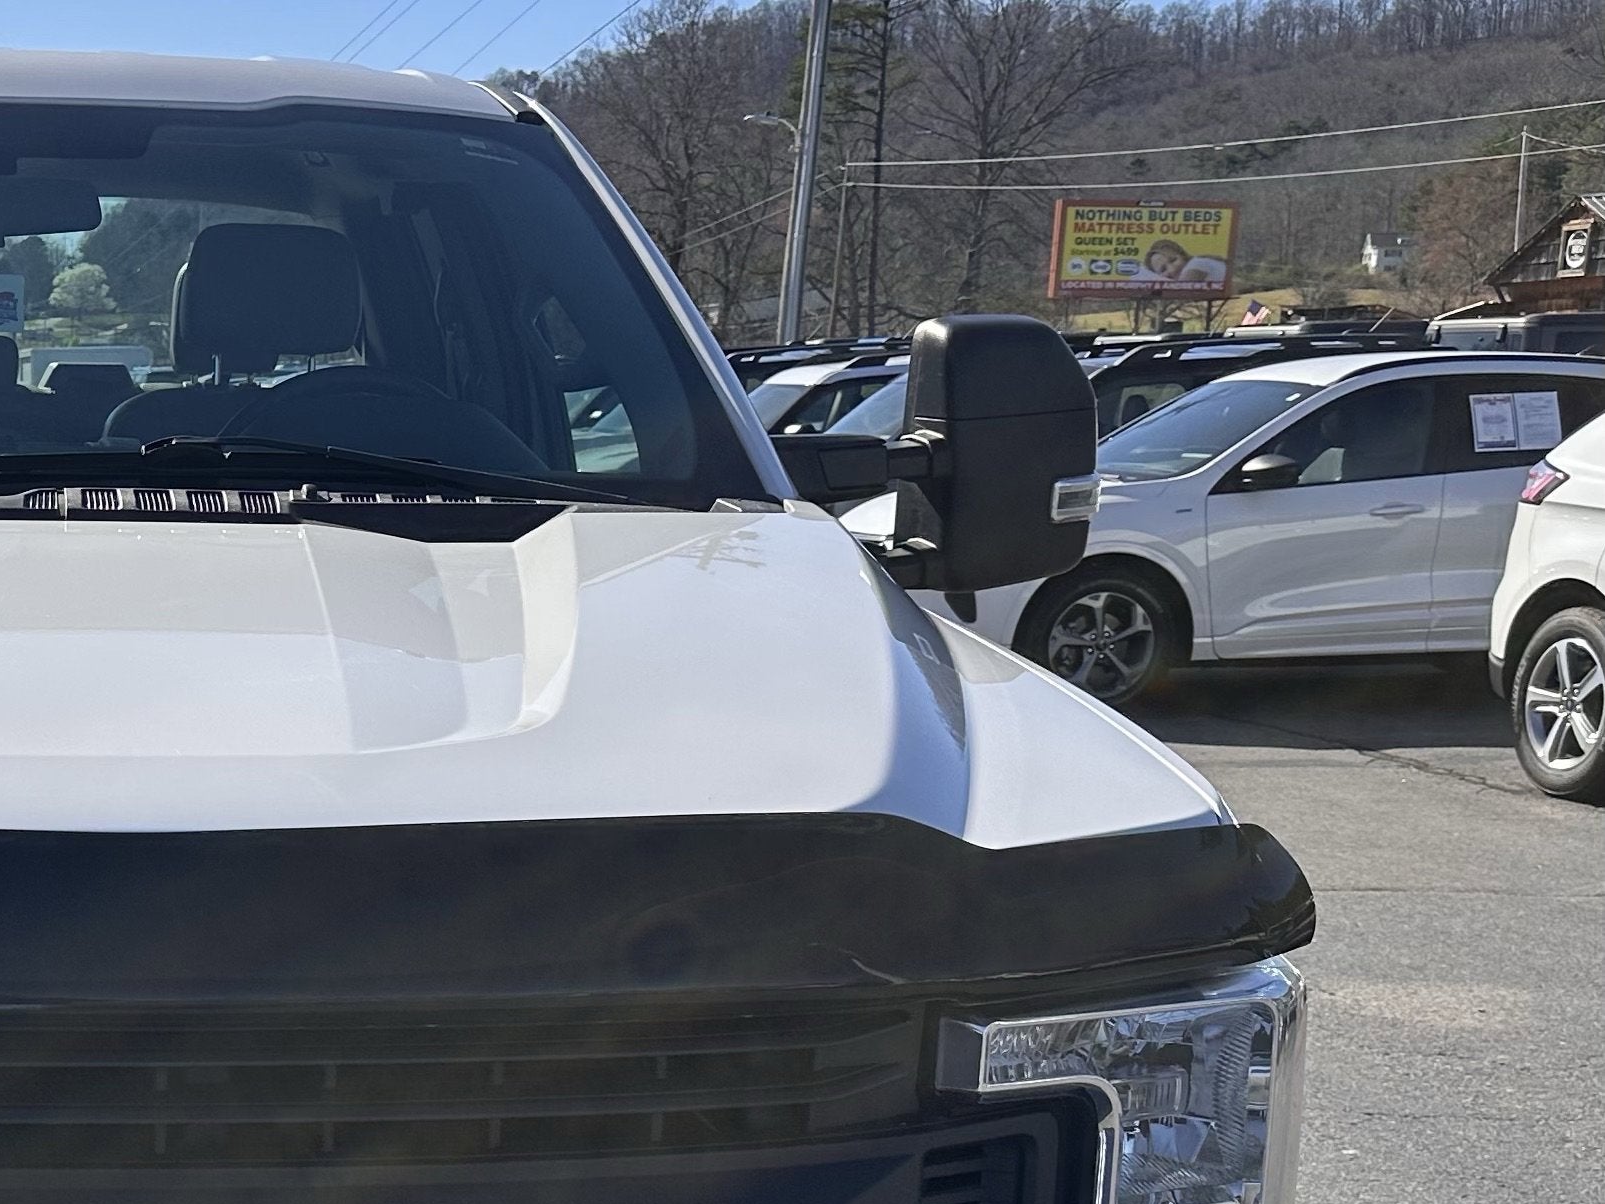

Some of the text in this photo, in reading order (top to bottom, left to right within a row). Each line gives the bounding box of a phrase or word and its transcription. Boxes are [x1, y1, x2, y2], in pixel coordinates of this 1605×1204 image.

[1074, 209, 1222, 222] NOTHING BUT BEDS
[1073, 222, 1221, 235] MATTRESS OUTLET
[1075, 236, 1137, 246] QUEEN SET
[1061, 281, 1104, 290] LOCATED
